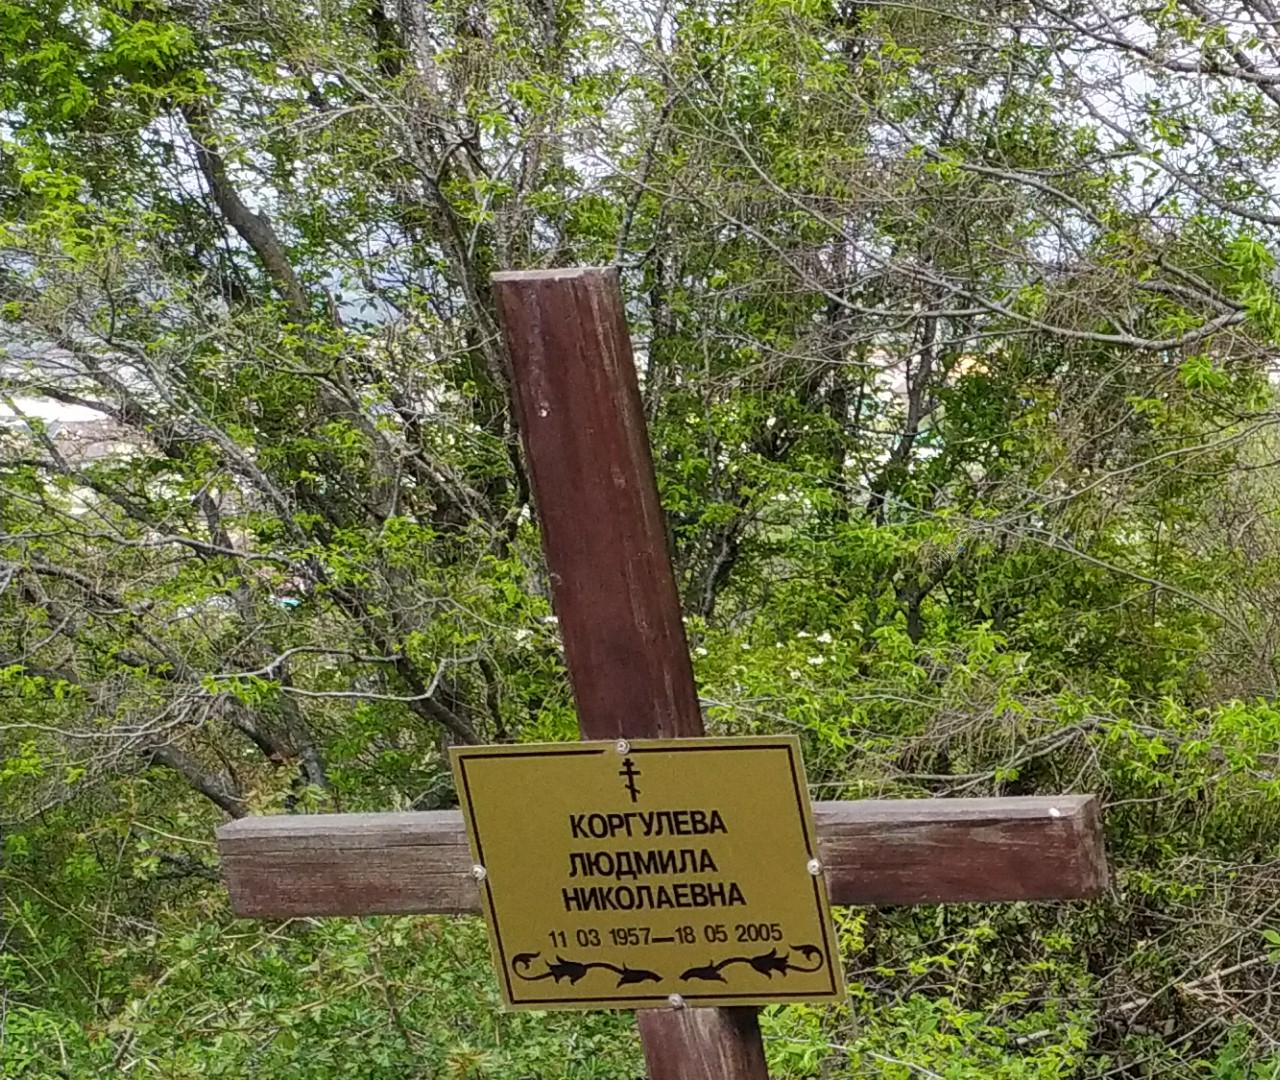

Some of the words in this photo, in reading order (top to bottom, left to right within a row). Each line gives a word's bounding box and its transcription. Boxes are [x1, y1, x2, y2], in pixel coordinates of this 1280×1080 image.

[568, 809, 729, 839] КОРГУЛЕВА
[568, 848, 719, 882] ЛЮДМИЛА
[561, 882, 748, 913] НИКОЛАЕВНА
[547, 929, 568, 949] 11
[575, 927, 602, 948] 03
[703, 923, 729, 944] 05
[734, 922, 784, 943] 2005
